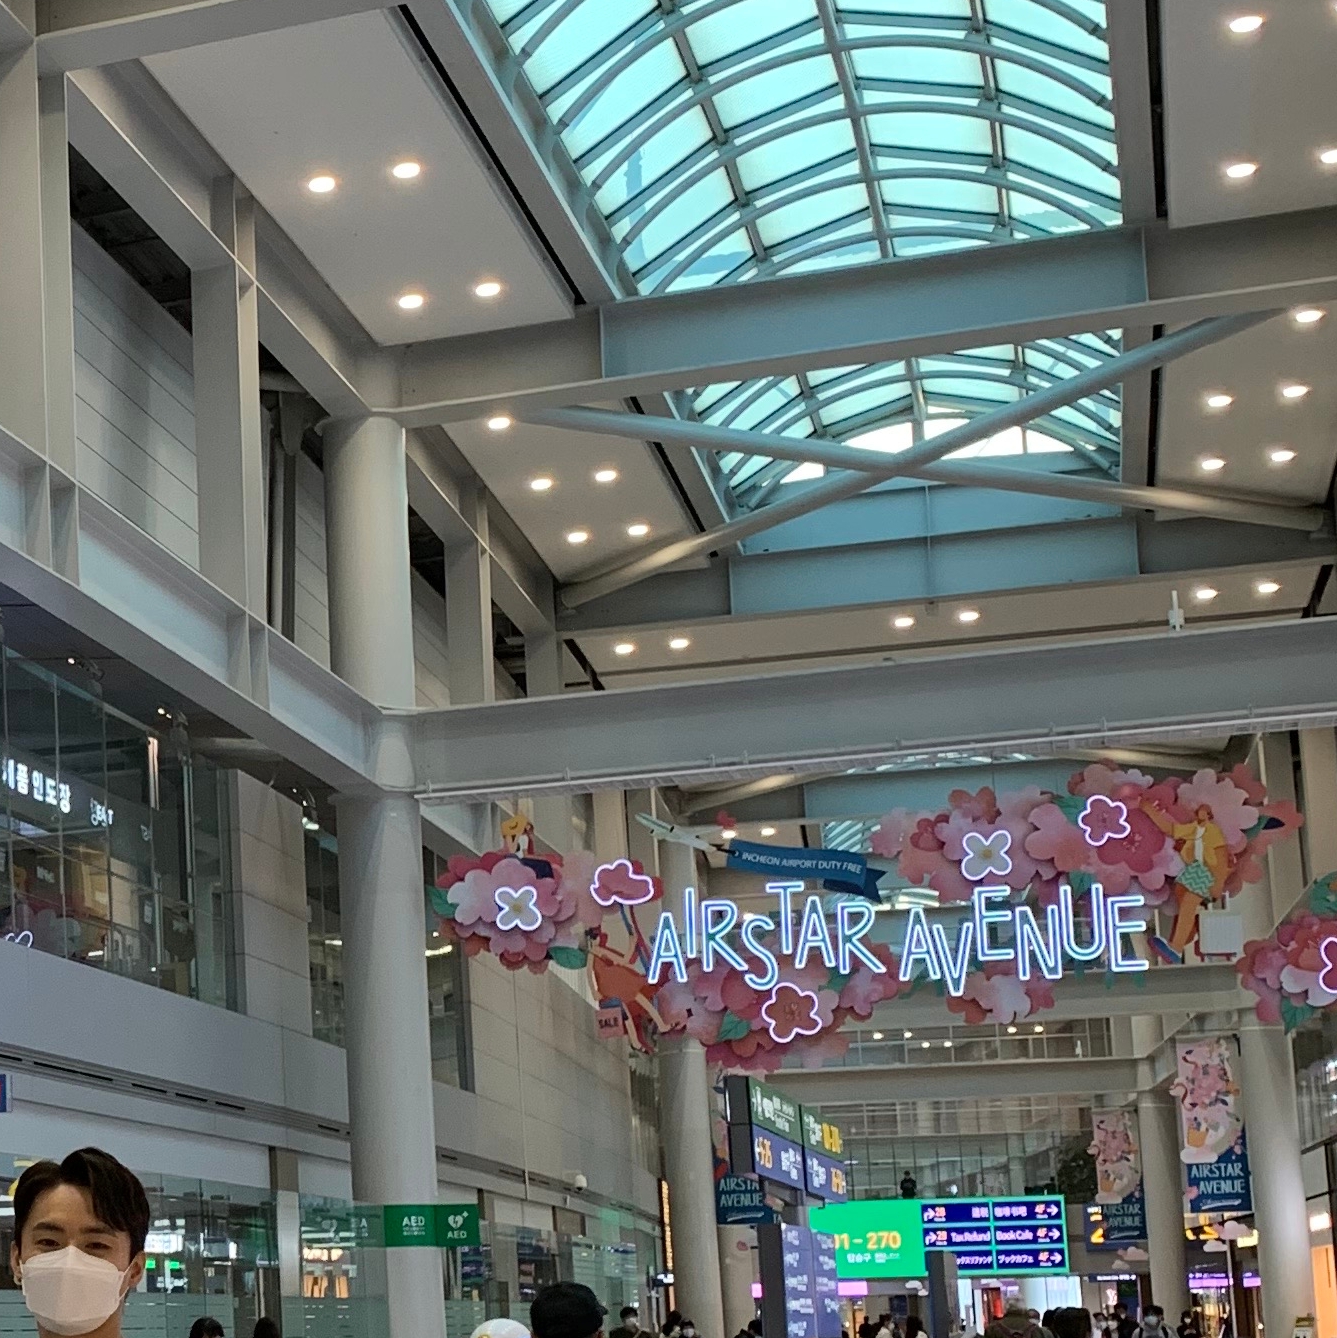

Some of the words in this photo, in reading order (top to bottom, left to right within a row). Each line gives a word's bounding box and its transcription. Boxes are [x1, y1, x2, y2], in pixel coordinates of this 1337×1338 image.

[818, 860, 842, 870] DUTY
[842, 861, 862, 874] FREE
[647, 880, 887, 991] AIRSTAR
[899, 883, 1150, 997] AVENUE
[1190, 1163, 1245, 1178] AIRSTAR
[1199, 1179, 1245, 1195] AVENUE
[403, 1216, 425, 1226] AED
